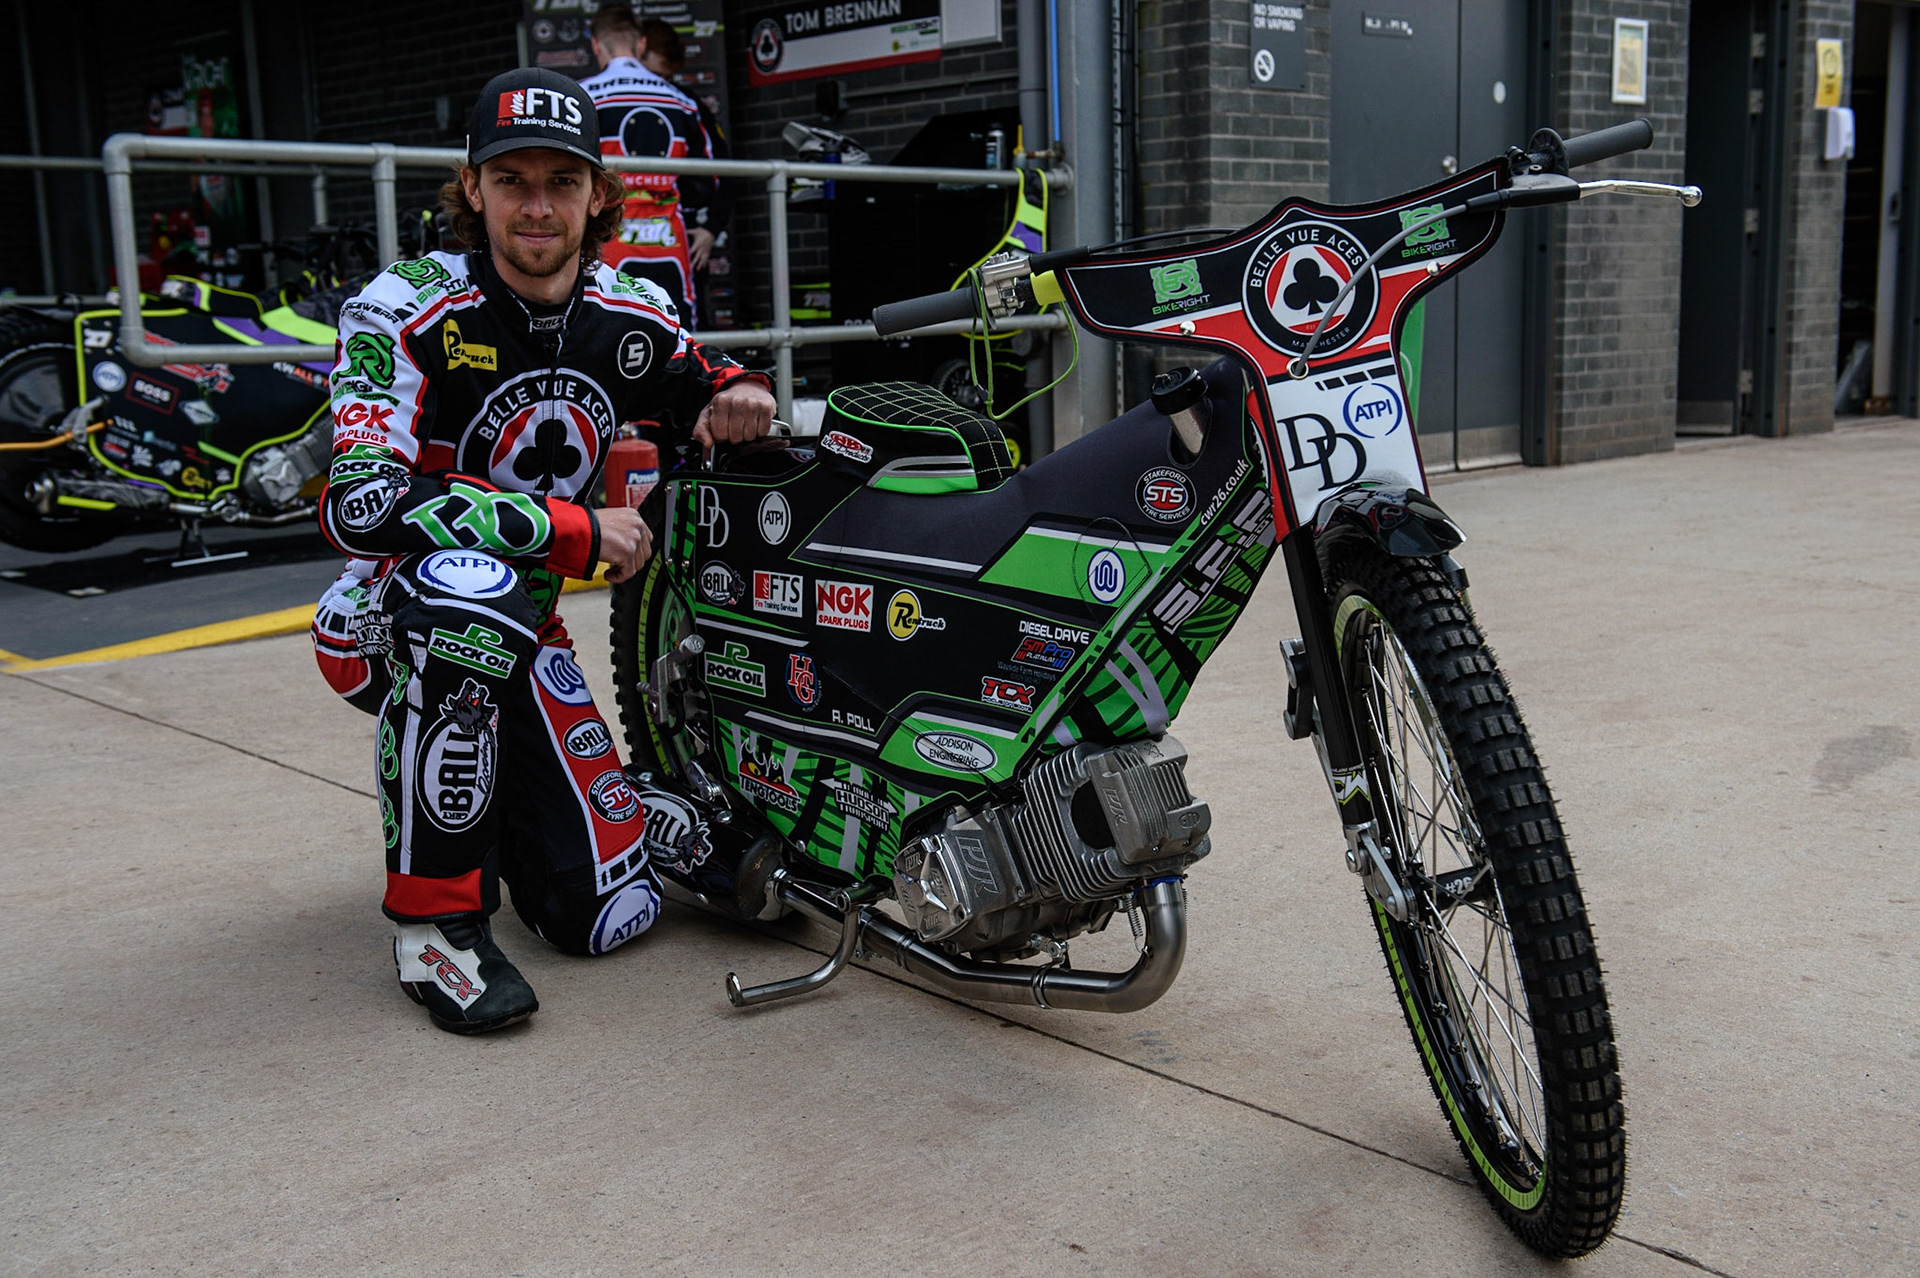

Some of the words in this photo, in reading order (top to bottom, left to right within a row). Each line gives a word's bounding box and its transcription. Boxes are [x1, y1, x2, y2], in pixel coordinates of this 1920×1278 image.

[785, 12, 820, 34] TOM
[825, 0, 902, 27] BRENNAN
[525, 87, 583, 126] FTS
[496, 119, 512, 128] Fire
[512, 117, 547, 128] Training
[547, 118, 582, 136] Services
[1250, 240, 1283, 288] BELLE
[1286, 229, 1321, 244] VUE
[1326, 233, 1363, 266] ACES
[1401, 238, 1457, 259] BIKERIGHT
[1152, 293, 1211, 315] BIKERIGHT
[333, 402, 395, 433] NGK
[478, 386, 531, 441] BELLE
[536, 379, 577, 398] VUE
[581, 392, 612, 439] ACES
[1354, 399, 1393, 423] ATPI
[347, 430, 388, 444] PLUGS
[1143, 469, 1187, 484] STAKEFORD
[1146, 485, 1185, 504] STS
[1199, 458, 1250, 527] cwr26.co.uk
[764, 509, 784, 526] ATPI
[1142, 504, 1159, 519] TYRE
[1159, 506, 1191, 520] SERVICES
[435, 557, 497, 573] ATPI
[770, 574, 801, 604] FTS
[818, 584, 872, 618] NGK
[755, 600, 763, 608] Fire
[764, 600, 780, 612] Training
[780, 603, 798, 613] Services
[894, 602, 945, 629] Rentruck
[818, 614, 843, 627] SPARK
[844, 618, 869, 630] PLUGS
[1018, 620, 1054, 639] DIESEL
[1054, 627, 1090, 645] DAVE
[433, 636, 484, 661] ROCK
[485, 653, 512, 673] OIL
[707, 662, 740, 681] ROCK
[741, 670, 764, 687] OIL
[983, 678, 1034, 705] TCX
[831, 709, 844, 725] A.
[846, 713, 875, 733] POLL
[936, 736, 974, 752] ADDISON
[600, 782, 631, 809] STS
[837, 790, 888, 823] HUDSON
[606, 811, 625, 821] TYRE
[608, 903, 651, 947] ATPI
[418, 945, 482, 1001] TCX
